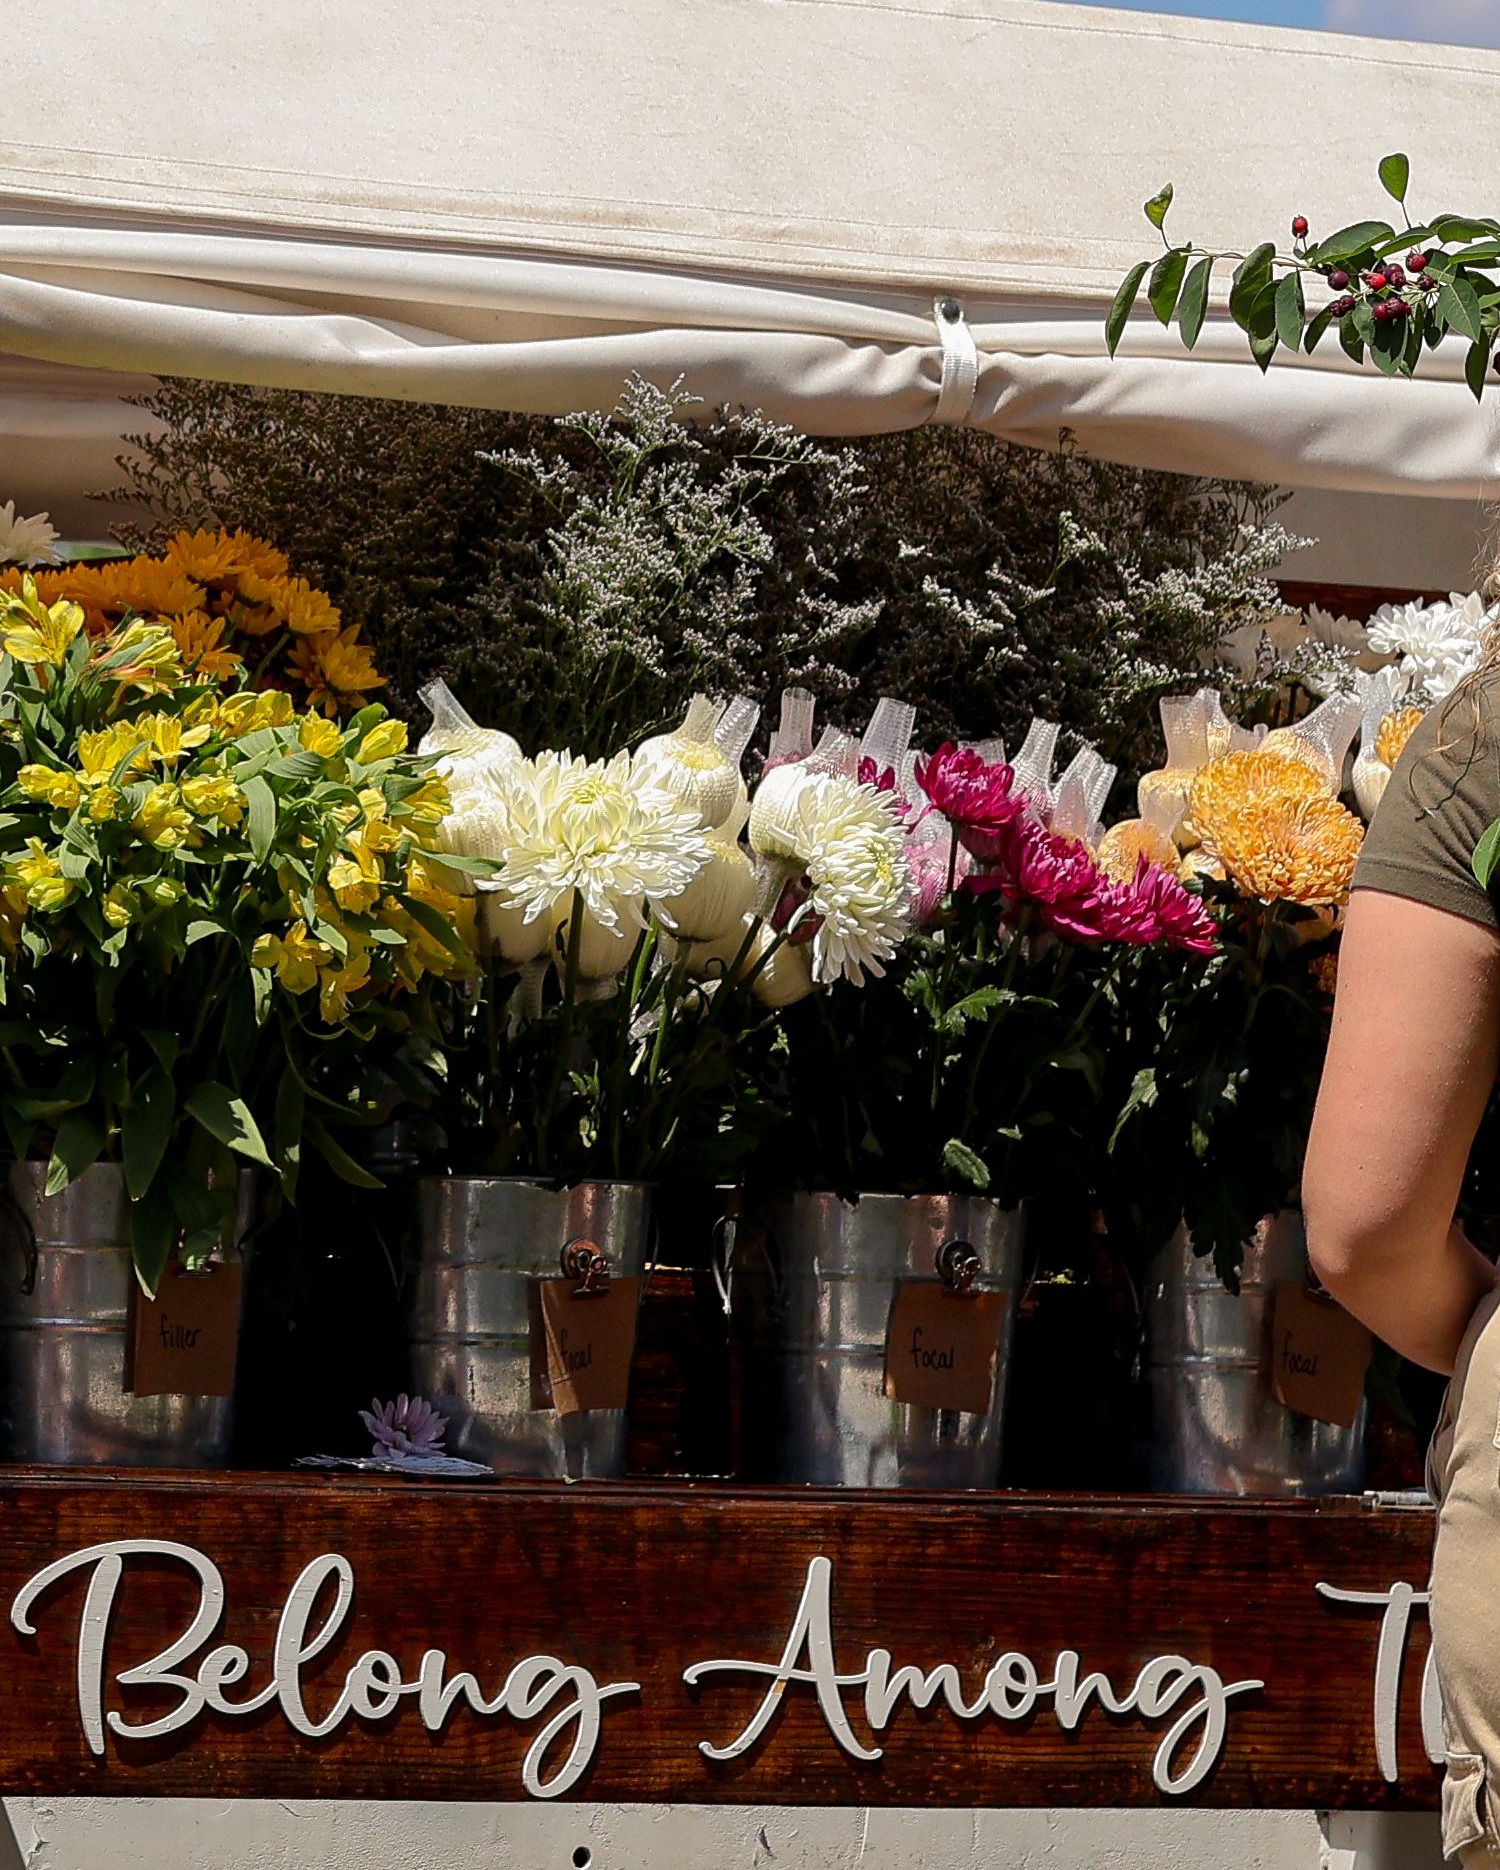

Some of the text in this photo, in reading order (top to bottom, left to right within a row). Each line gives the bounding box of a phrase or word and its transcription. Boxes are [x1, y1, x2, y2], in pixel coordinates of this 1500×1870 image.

[159, 1313, 202, 1350] filler
[910, 1326, 954, 1370] focal
[1281, 1330, 1319, 1377] focal
[10, 1538, 642, 1799] Belong
[682, 1555, 1265, 1796] Among
